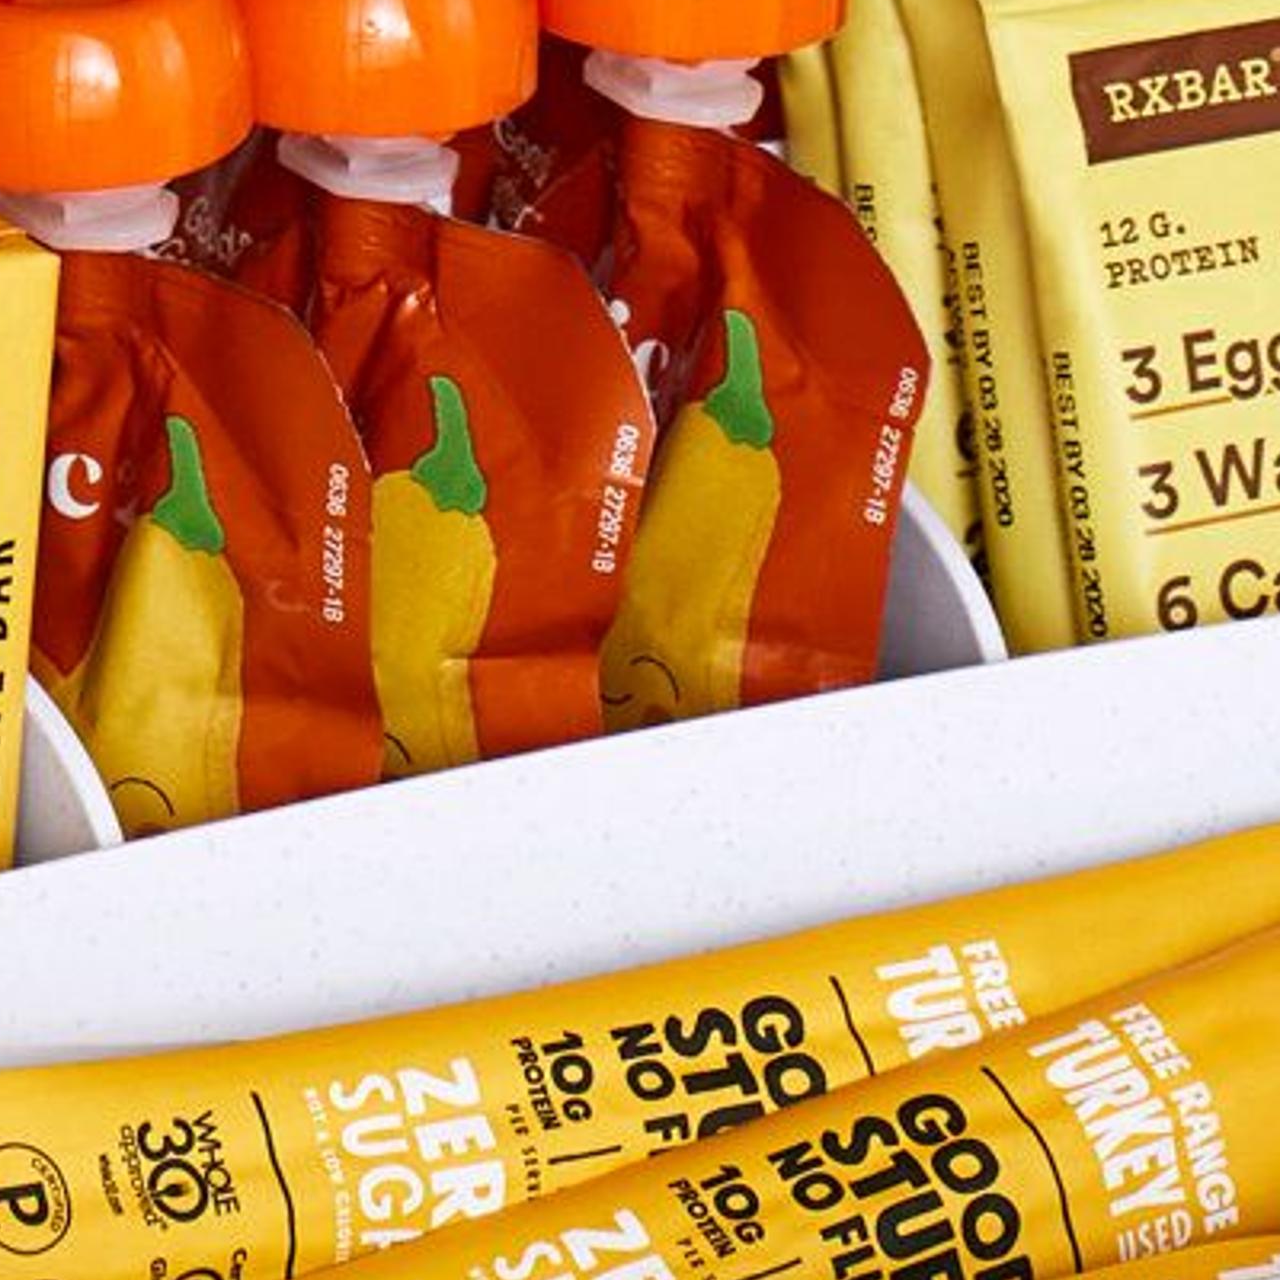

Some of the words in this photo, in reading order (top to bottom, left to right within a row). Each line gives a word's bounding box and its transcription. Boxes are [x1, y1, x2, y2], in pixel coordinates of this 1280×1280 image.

[1103, 55, 1278, 124] RXBAR
[1098, 216, 1140, 251] 12
[1147, 211, 1188, 243] G.
[1105, 236, 1261, 290] PROTEIN
[961, 240, 987, 321] BEST
[971, 328, 995, 369] BY
[1122, 346, 1163, 406] 3
[978, 371, 1001, 412] 03
[1052, 350, 1081, 432] BEST
[989, 455, 1015, 529] 2020
[1061, 436, 1090, 484] BY
[1139, 462, 1180, 521] 3
[1069, 484, 1091, 522] 03
[1081, 567, 1111, 640] 2020
[1156, 573, 1199, 634] 6
[961, 939, 1027, 1031] FREE
[509, 1035, 564, 1133] PROTEIN
[539, 1029, 594, 1123] 10G
[610, 1022, 677, 1101] NO
[1026, 1019, 1188, 1218] TURKEY
[1111, 1002, 1193, 1081] FREE
[1169, 1080, 1241, 1234] RANGE
[118, 1123, 168, 1228] approved
[135, 1116, 211, 1223] 30
[190, 1107, 243, 1217] WHOLE
[767, 1141, 847, 1213] NO
[667, 1177, 738, 1261] PROTEIN
[700, 1163, 767, 1247] 10G
